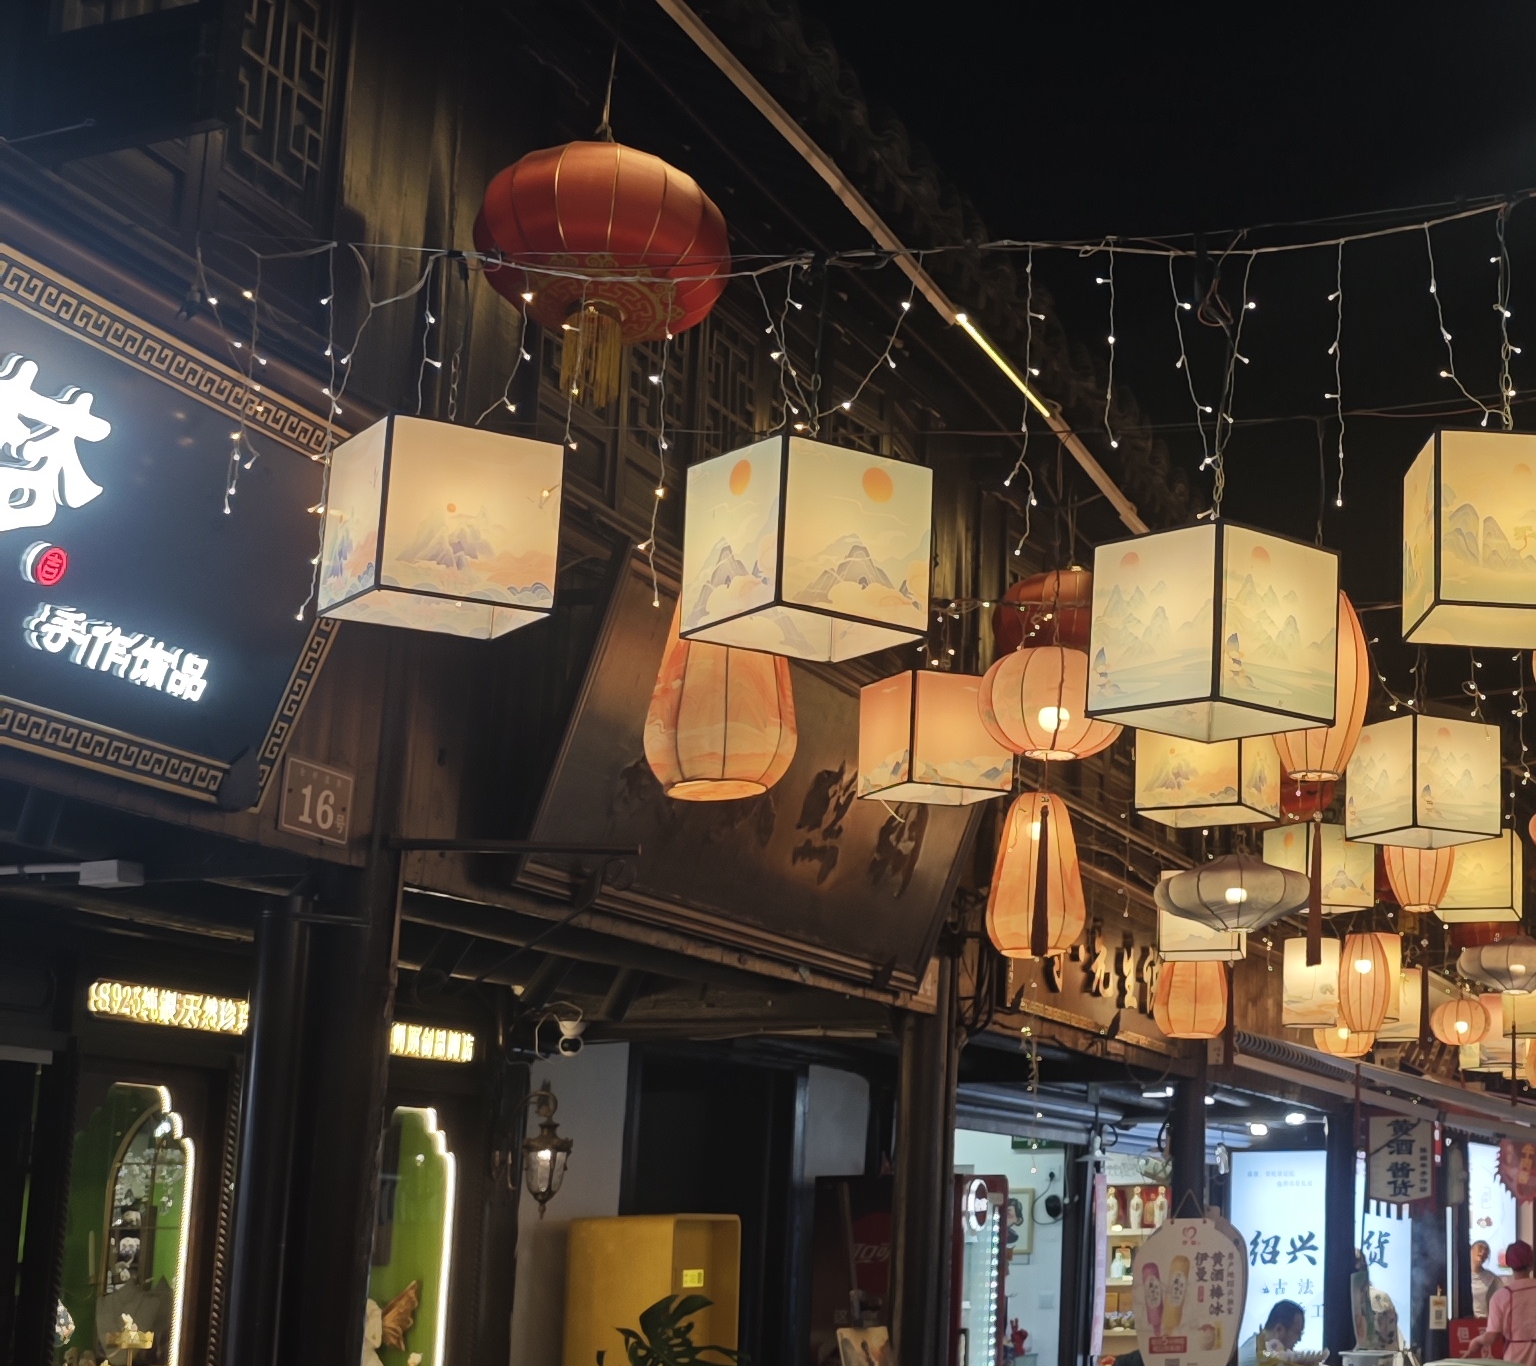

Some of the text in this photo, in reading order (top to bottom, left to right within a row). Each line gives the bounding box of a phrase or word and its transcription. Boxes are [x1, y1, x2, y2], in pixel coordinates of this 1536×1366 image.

[1250, 1230, 1391, 1269] 绍兴 货
[1209, 1251, 1225, 1316] 黄酒棒冰
